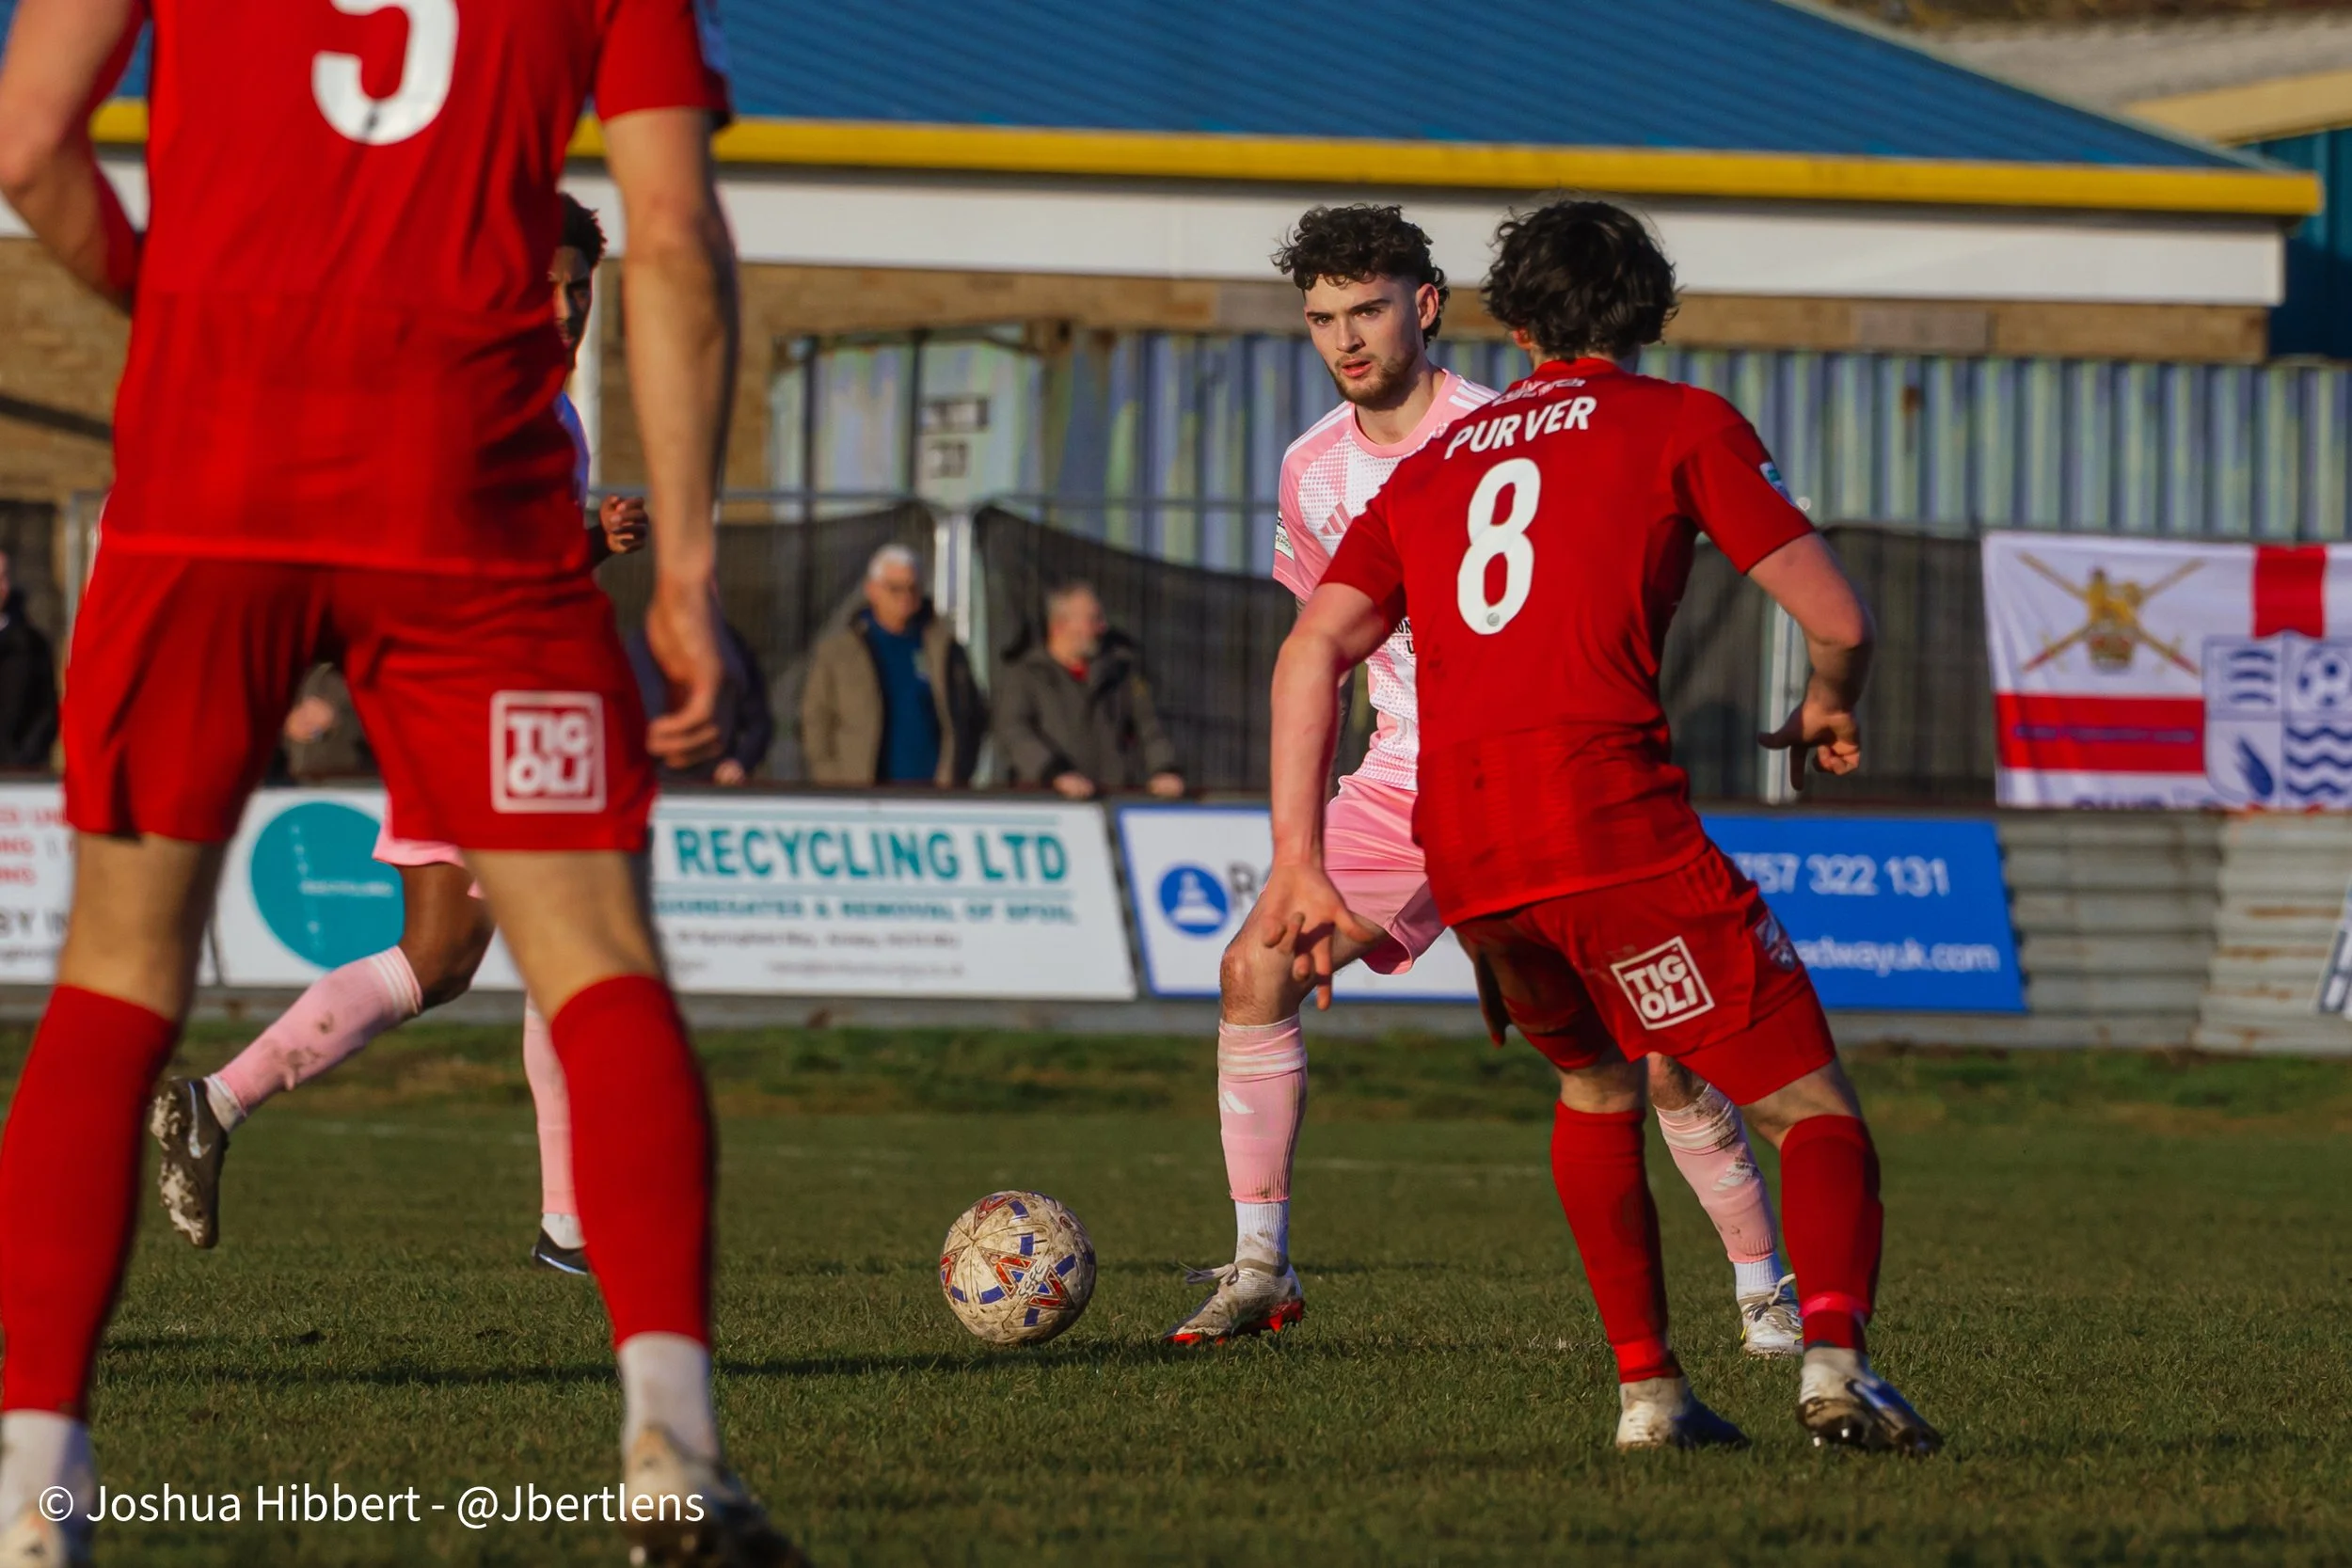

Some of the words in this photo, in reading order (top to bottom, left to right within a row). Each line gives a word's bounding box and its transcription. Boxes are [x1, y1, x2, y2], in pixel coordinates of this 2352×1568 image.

[1443, 395, 1597, 460] PURVER
[1457, 457, 1541, 636] 8
[675, 824, 960, 879] RECYCLING
[977, 830, 1069, 881] LTD
[1806, 853, 1879, 896] 322
[1884, 855, 1950, 897] 131
[1623, 955, 1688, 994] TIG
[1640, 975, 1698, 1020] OLI
